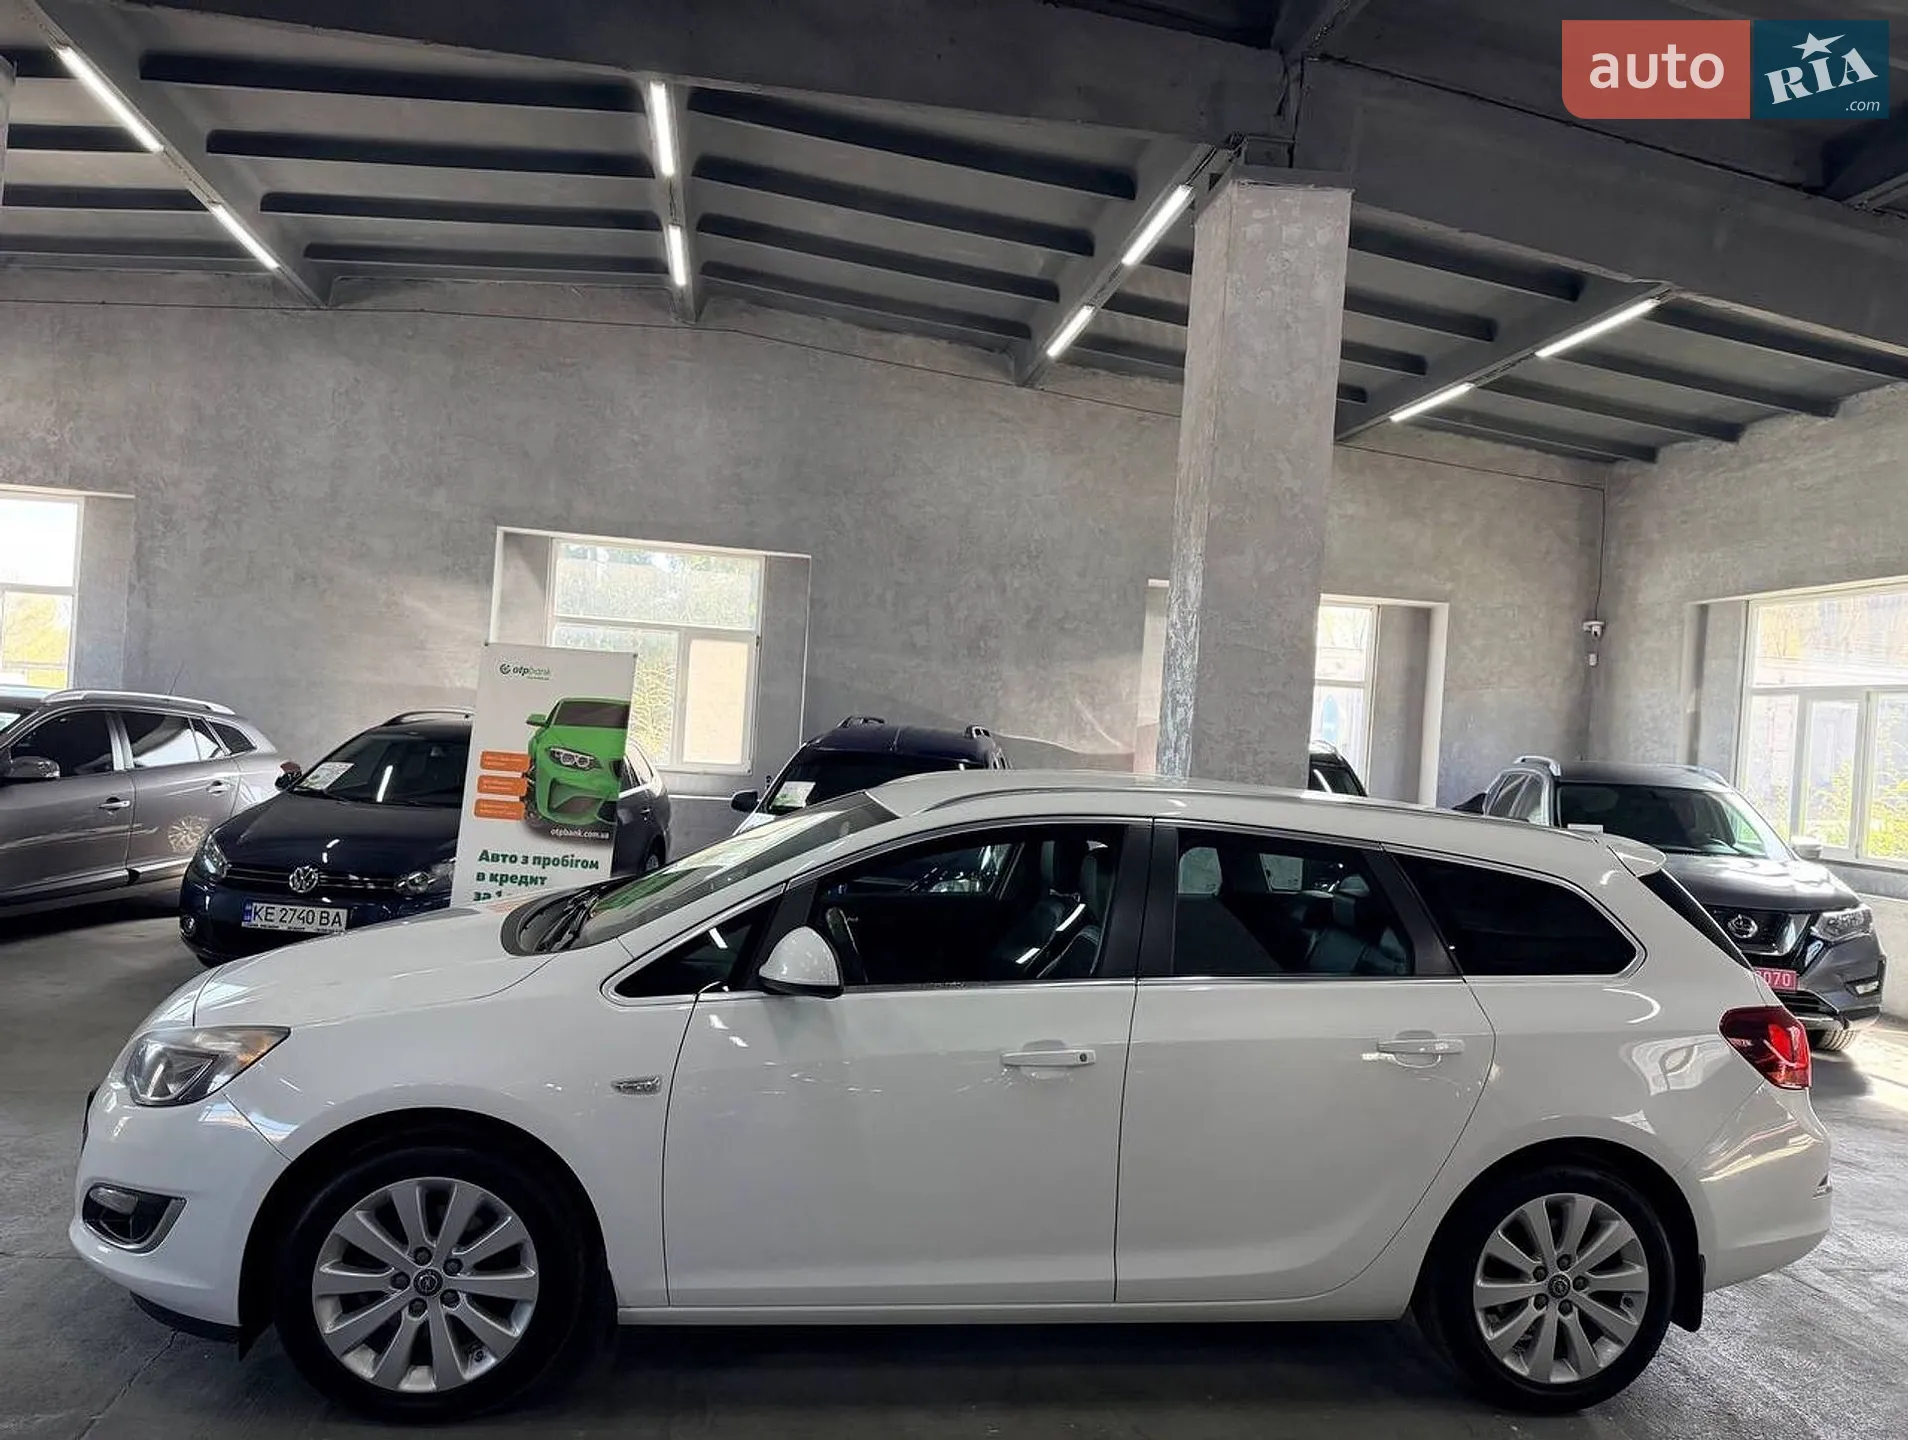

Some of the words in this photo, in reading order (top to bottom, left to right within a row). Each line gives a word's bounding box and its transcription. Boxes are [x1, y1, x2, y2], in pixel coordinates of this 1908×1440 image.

[478, 849, 518, 864] Авто
[520, 855, 529, 865] з
[532, 854, 600, 869] пробігом
[476, 871, 486, 882] в
[489, 872, 548, 887] кредит
[253, 905, 276, 922] KE
[279, 907, 316, 925] 2740
[319, 910, 342, 927] BA
